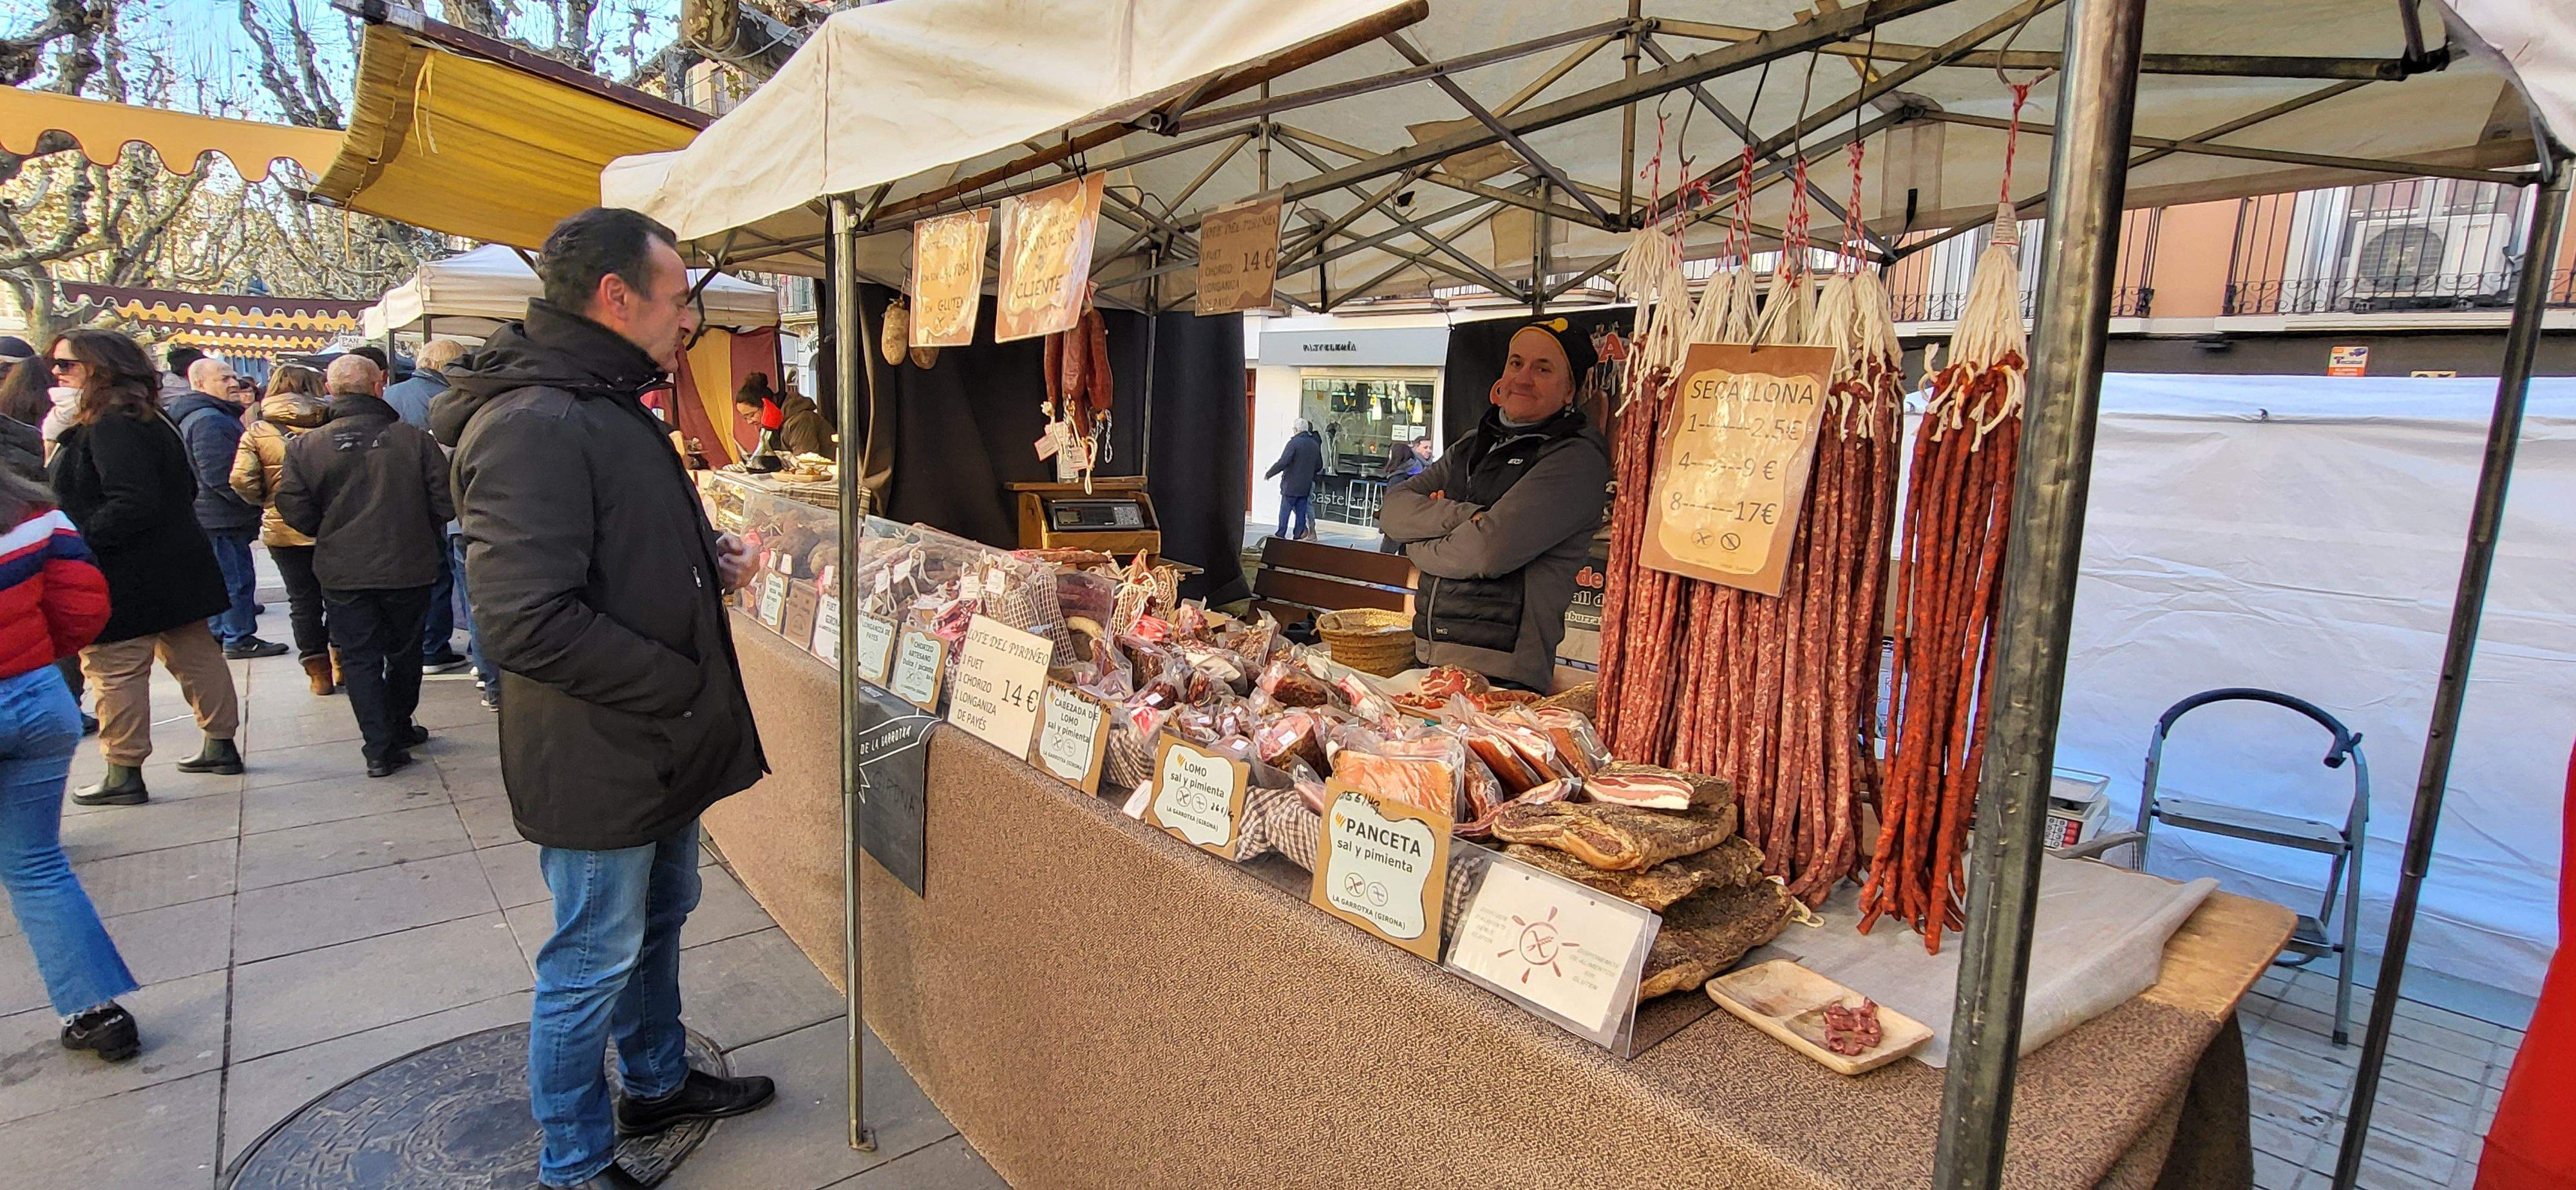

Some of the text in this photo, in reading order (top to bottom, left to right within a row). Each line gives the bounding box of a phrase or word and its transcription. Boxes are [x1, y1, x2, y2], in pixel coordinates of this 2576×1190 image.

[1242, 250, 1260, 273] 14
[1016, 274, 1065, 299] CLIENTE
[967, 628, 989, 645] LOTE
[989, 636, 1008, 652] DEL
[967, 656, 984, 670] FUET
[963, 674, 992, 694] CHORIZO
[1001, 679, 1039, 712] 14 €
[960, 690, 996, 716] LONGANIZA
[1054, 698, 1086, 717] CABEZADA
[1088, 710, 1099, 721] DE
[957, 708, 987, 732] DE PAYÉS
[1061, 713, 1079, 726] LOMO
[1047, 721, 1090, 743] sal y pimienta
[860, 742, 869, 755] DE
[871, 739, 879, 751] LA
[1184, 762, 1207, 777] LOMO
[1170, 772, 1224, 798] sal y pimienta
[1173, 808, 1195, 822] GARROTXA
[1196, 818, 1218, 832] (GIRONA)
[1346, 818, 1421, 857] PANCETA
[1337, 839, 1413, 873] sal y pimienta
[1332, 894, 1406, 930] LA GARROTXA (GIRONA)
